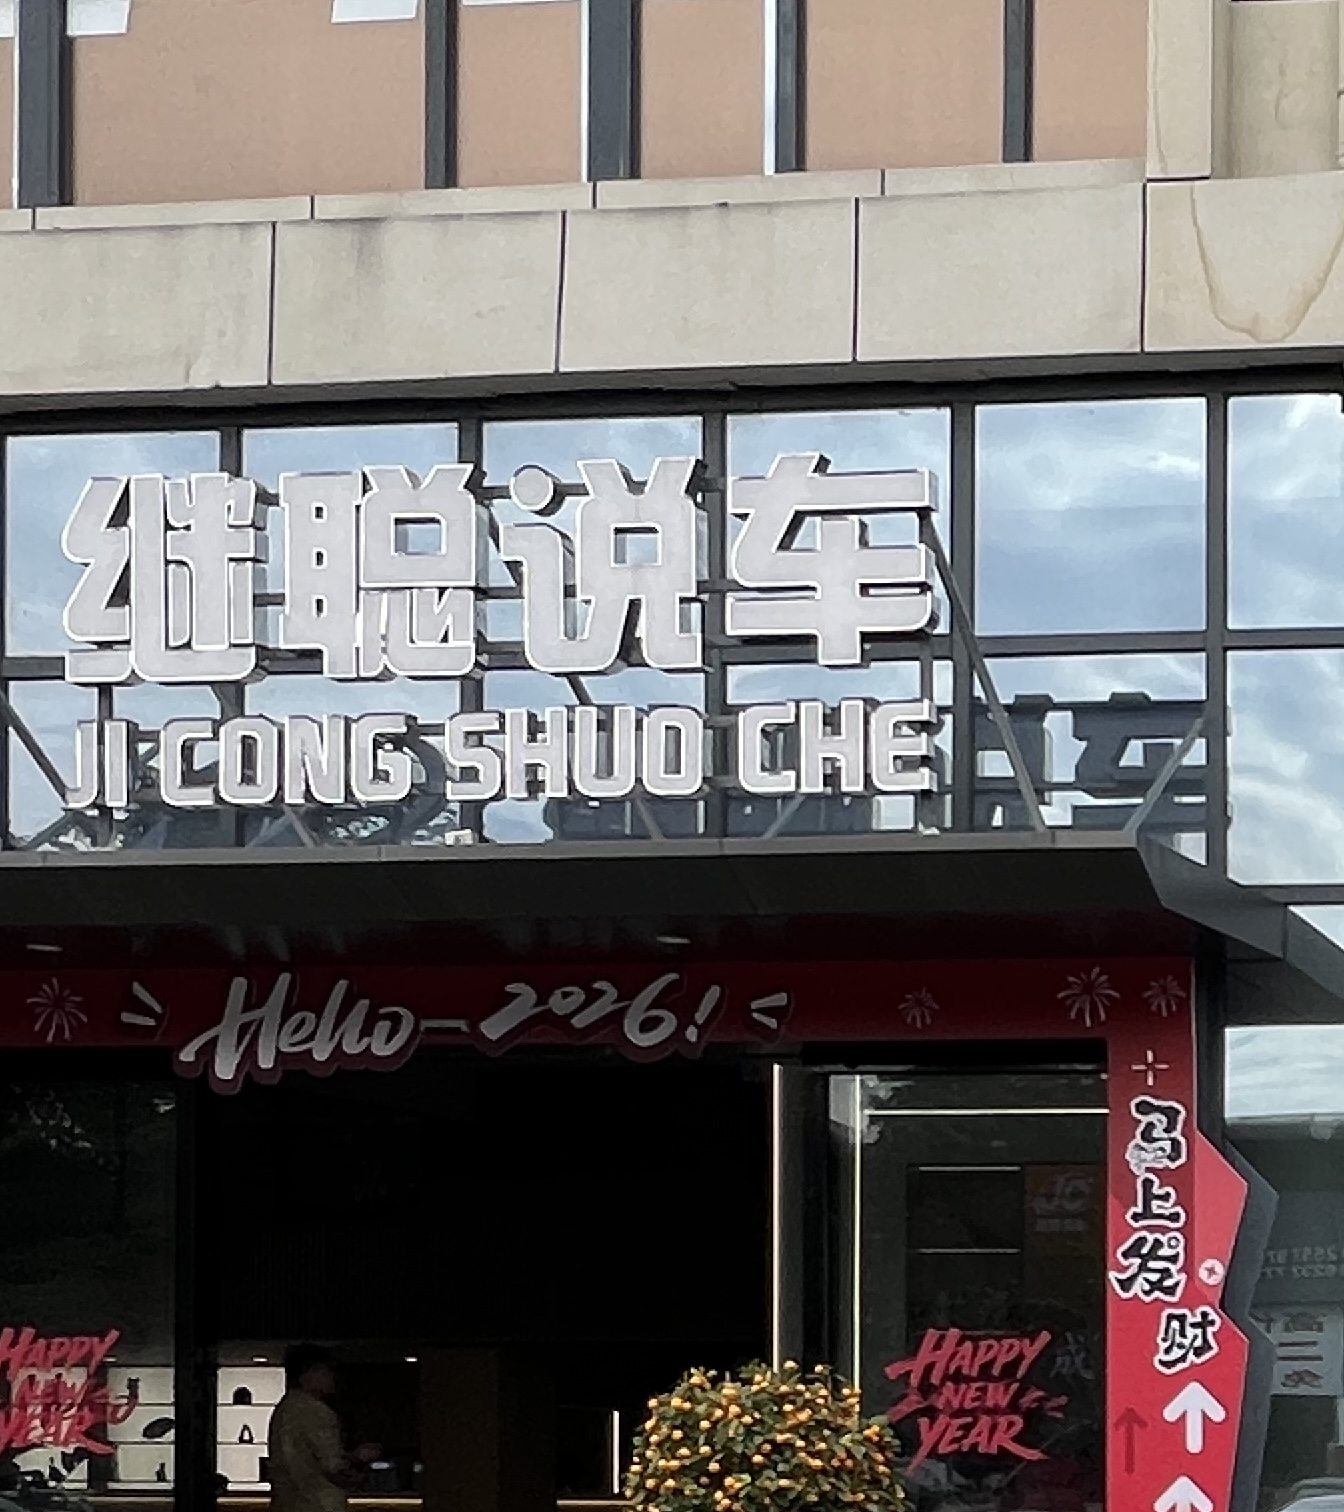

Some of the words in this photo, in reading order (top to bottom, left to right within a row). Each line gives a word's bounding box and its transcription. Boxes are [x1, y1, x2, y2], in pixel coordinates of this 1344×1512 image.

[60, 451, 939, 684] 继聪说车
[63, 718, 129, 809] JI
[159, 712, 413, 807] CONG
[444, 704, 703, 801] SHUO
[737, 698, 933, 794] CHE
[1108, 1095, 1222, 1375] 马上发财
[884, 1328, 1052, 1388] HAPPY
[936, 1382, 1020, 1410] NEW
[904, 1413, 1051, 1477] YEAR
